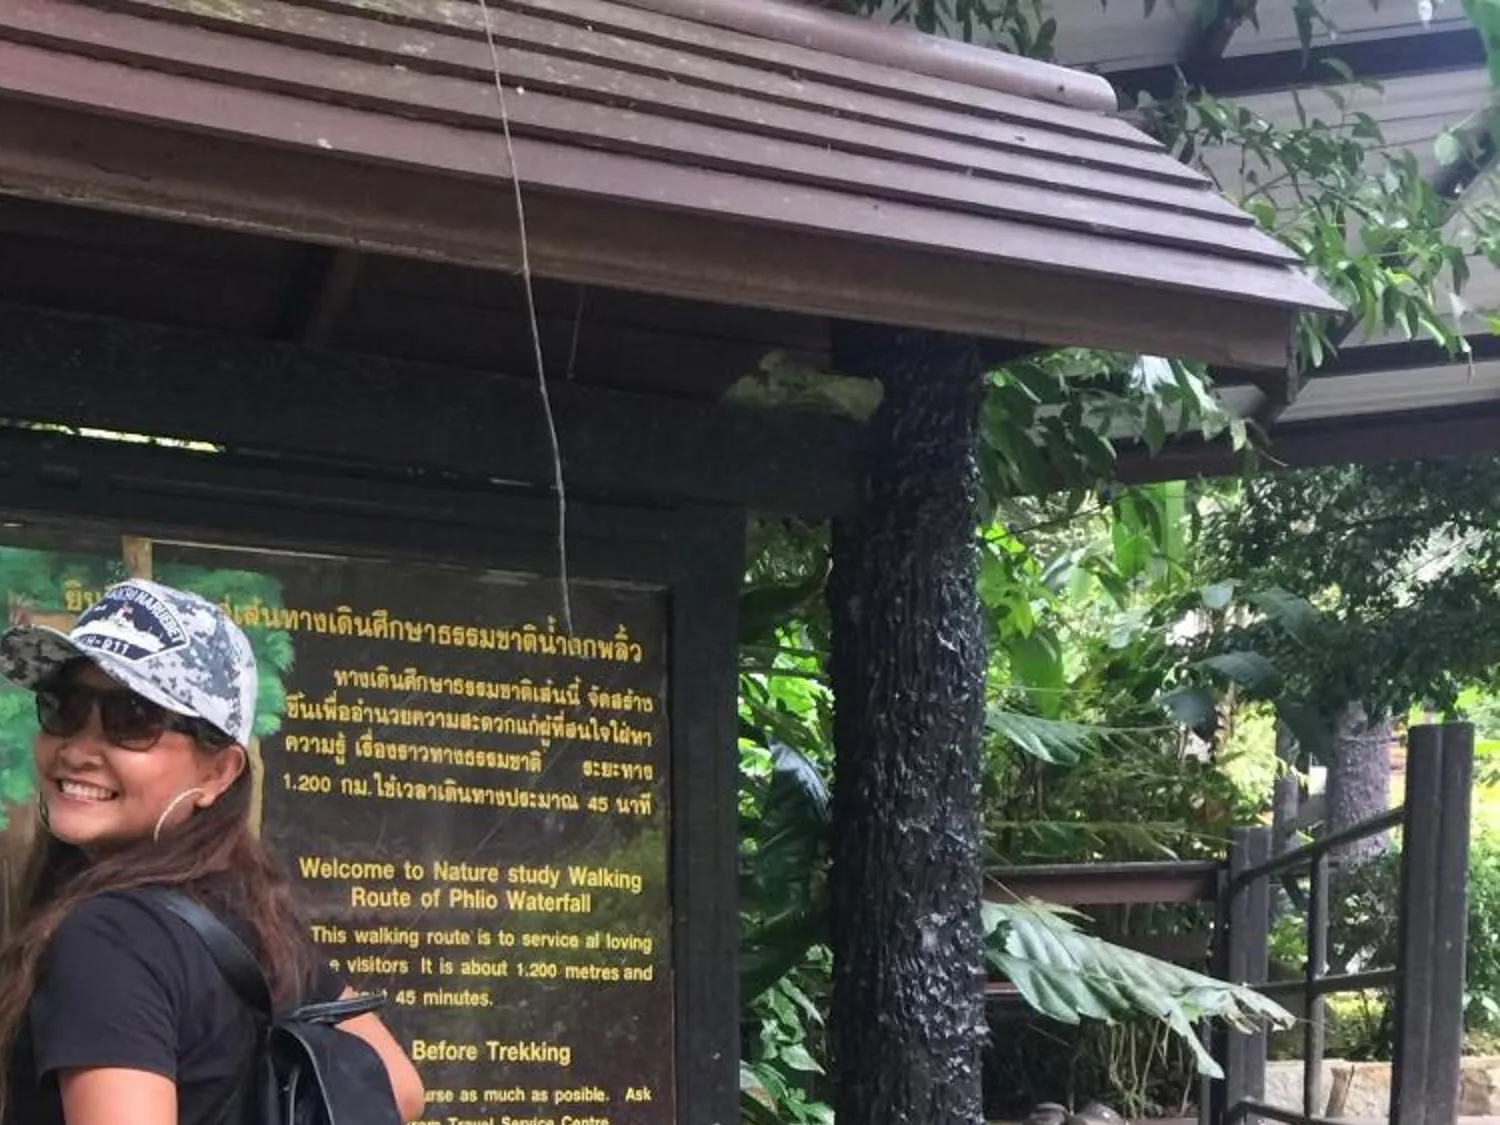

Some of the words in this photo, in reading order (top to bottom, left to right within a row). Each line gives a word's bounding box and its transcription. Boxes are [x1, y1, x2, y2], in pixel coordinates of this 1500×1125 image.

[283, 773, 331, 793] 1.200
[587, 797, 609, 813] 45
[299, 857, 395, 880] Welcome
[403, 861, 424, 881] to
[433, 860, 499, 884] Nature
[508, 864, 560, 889] study
[568, 865, 643, 894] Walking
[352, 886, 411, 907] Route
[420, 888, 441, 907] of
[506, 889, 591, 913] Waterfall
[311, 925, 347, 944] This
[355, 926, 419, 949] walking
[427, 930, 471, 945] route
[477, 928, 491, 945] is
[498, 930, 515, 947] to
[521, 931, 579, 949] service
[607, 933, 653, 955] loving
[348, 956, 409, 974] visitors
[421, 957, 433, 974] It
[440, 958, 453, 975] is
[461, 959, 508, 977] about
[516, 963, 557, 978] 1.200
[565, 964, 619, 981] metres
[623, 965, 653, 982] and
[395, 990, 417, 1004] 45
[423, 988, 494, 1007] minutes.
[411, 1039, 478, 1062] Before
[486, 1040, 572, 1067] Trekking
[460, 1089, 478, 1102] as
[484, 1085, 526, 1102] much
[531, 1088, 549, 1101] as
[625, 1087, 652, 1102] Ask
